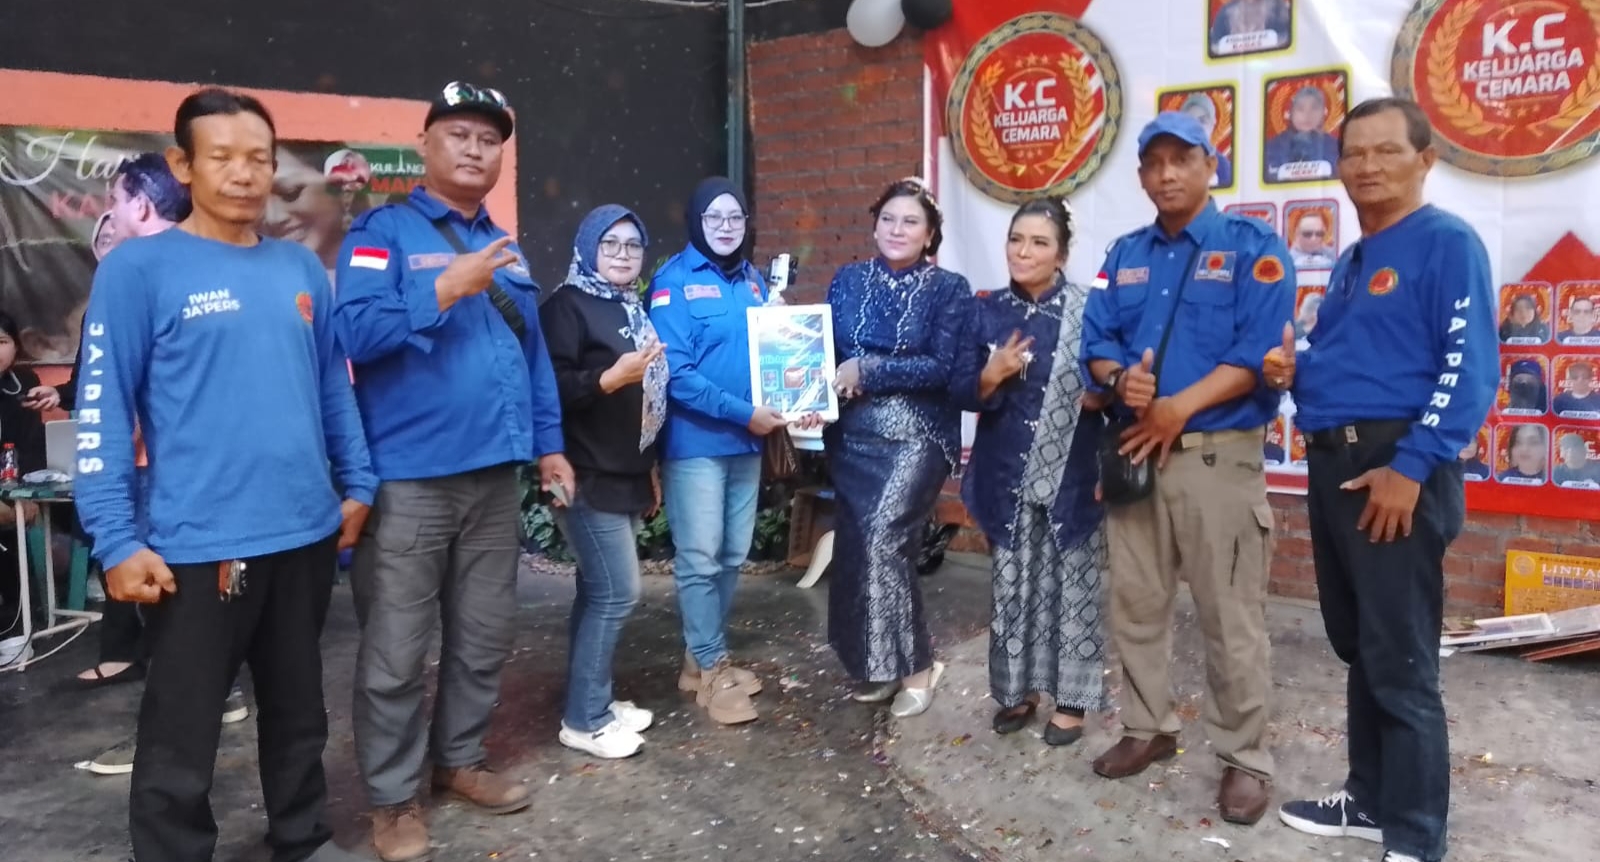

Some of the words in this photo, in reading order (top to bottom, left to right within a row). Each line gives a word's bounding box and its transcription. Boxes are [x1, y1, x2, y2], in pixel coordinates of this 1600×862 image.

[1482, 12, 1567, 58] K.C
[1463, 47, 1585, 82] KELUARGA
[1004, 78, 1057, 110] K.C
[1475, 71, 1571, 100] CEMARA
[994, 106, 1068, 128] KELUARGA
[1002, 125, 1061, 144] CEMARA
[182, 299, 241, 319] JA'PERS
[188, 288, 230, 305] IWAN
[1421, 296, 1470, 427] JA'PERS
